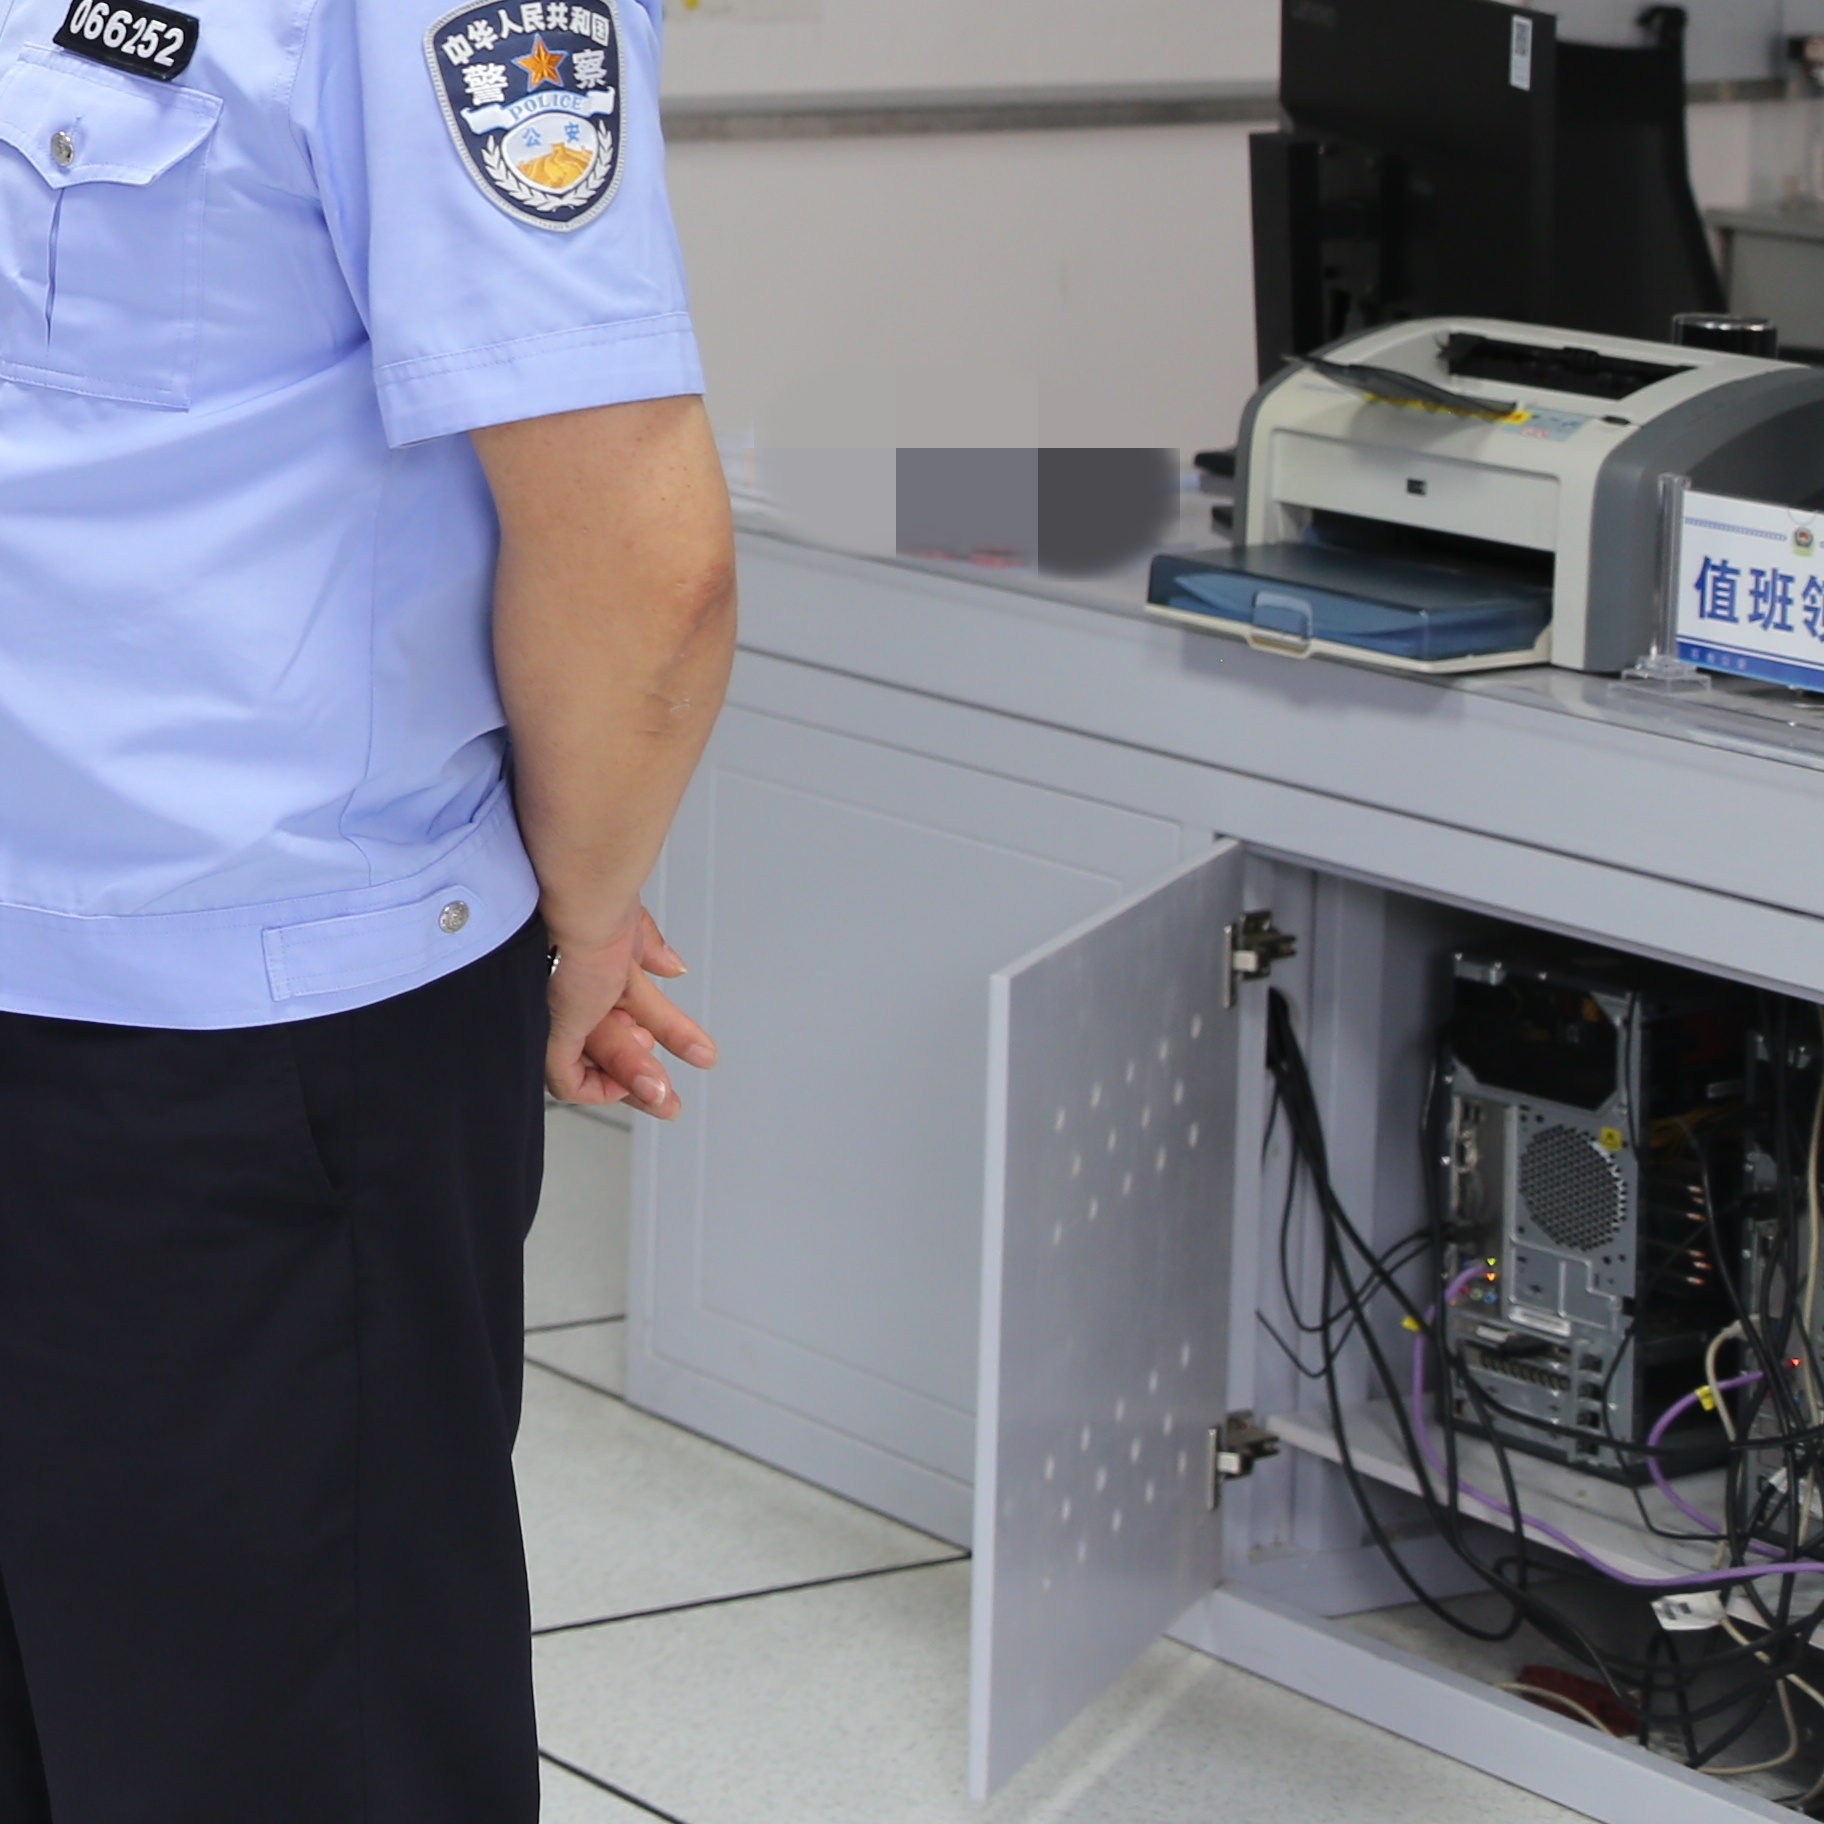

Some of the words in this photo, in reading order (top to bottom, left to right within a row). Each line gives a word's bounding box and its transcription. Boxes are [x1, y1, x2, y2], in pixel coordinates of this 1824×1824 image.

[442, 1, 610, 66] 中华人民共和国
[508, 93, 583, 121] POLICE
[522, 121, 581, 147] 公安
